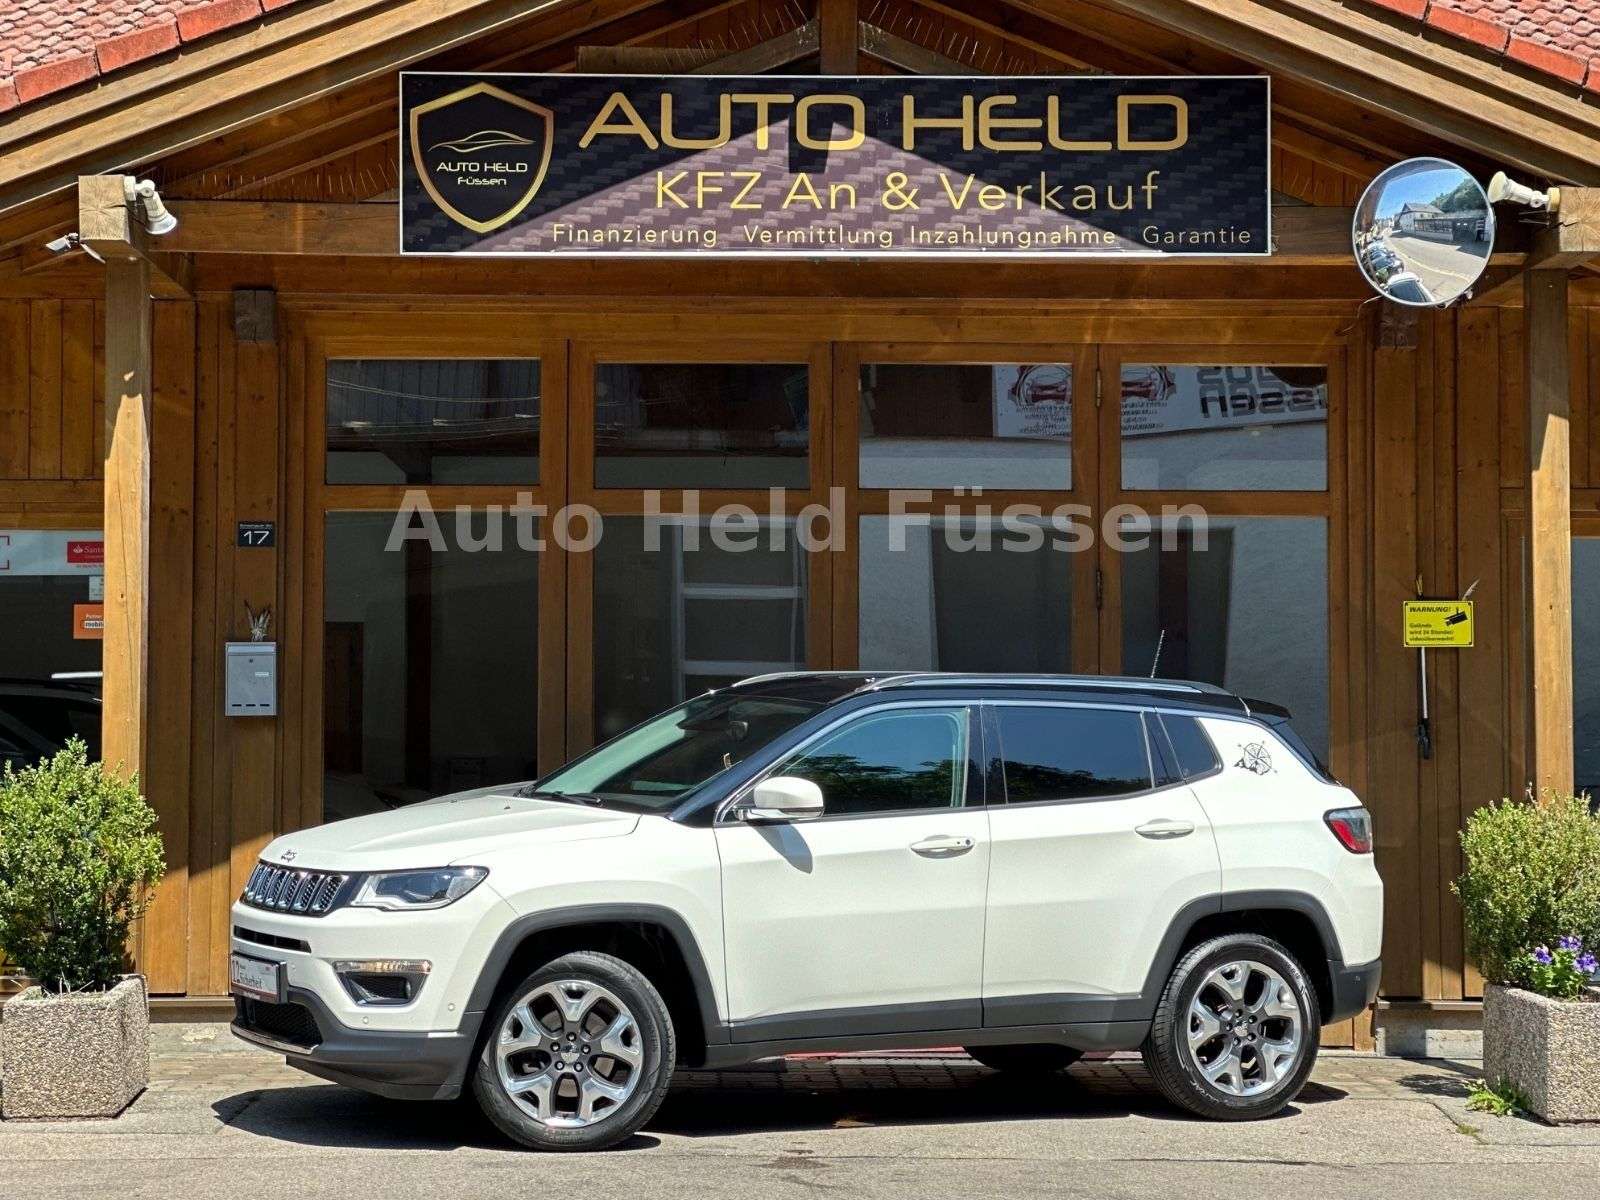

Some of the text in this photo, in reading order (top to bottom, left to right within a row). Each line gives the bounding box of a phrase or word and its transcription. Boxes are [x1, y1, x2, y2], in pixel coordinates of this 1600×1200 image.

[579, 92, 1189, 152] AUTO HELD
[436, 162, 528, 173] AUTO HELD
[457, 176, 507, 186] Füssen
[656, 169, 1161, 211] KFZ An & Verkauf
[552, 223, 1252, 248] Finanzierung Vermittlung Inzahlungnahme Garantie
[243, 530, 270, 545] 17
